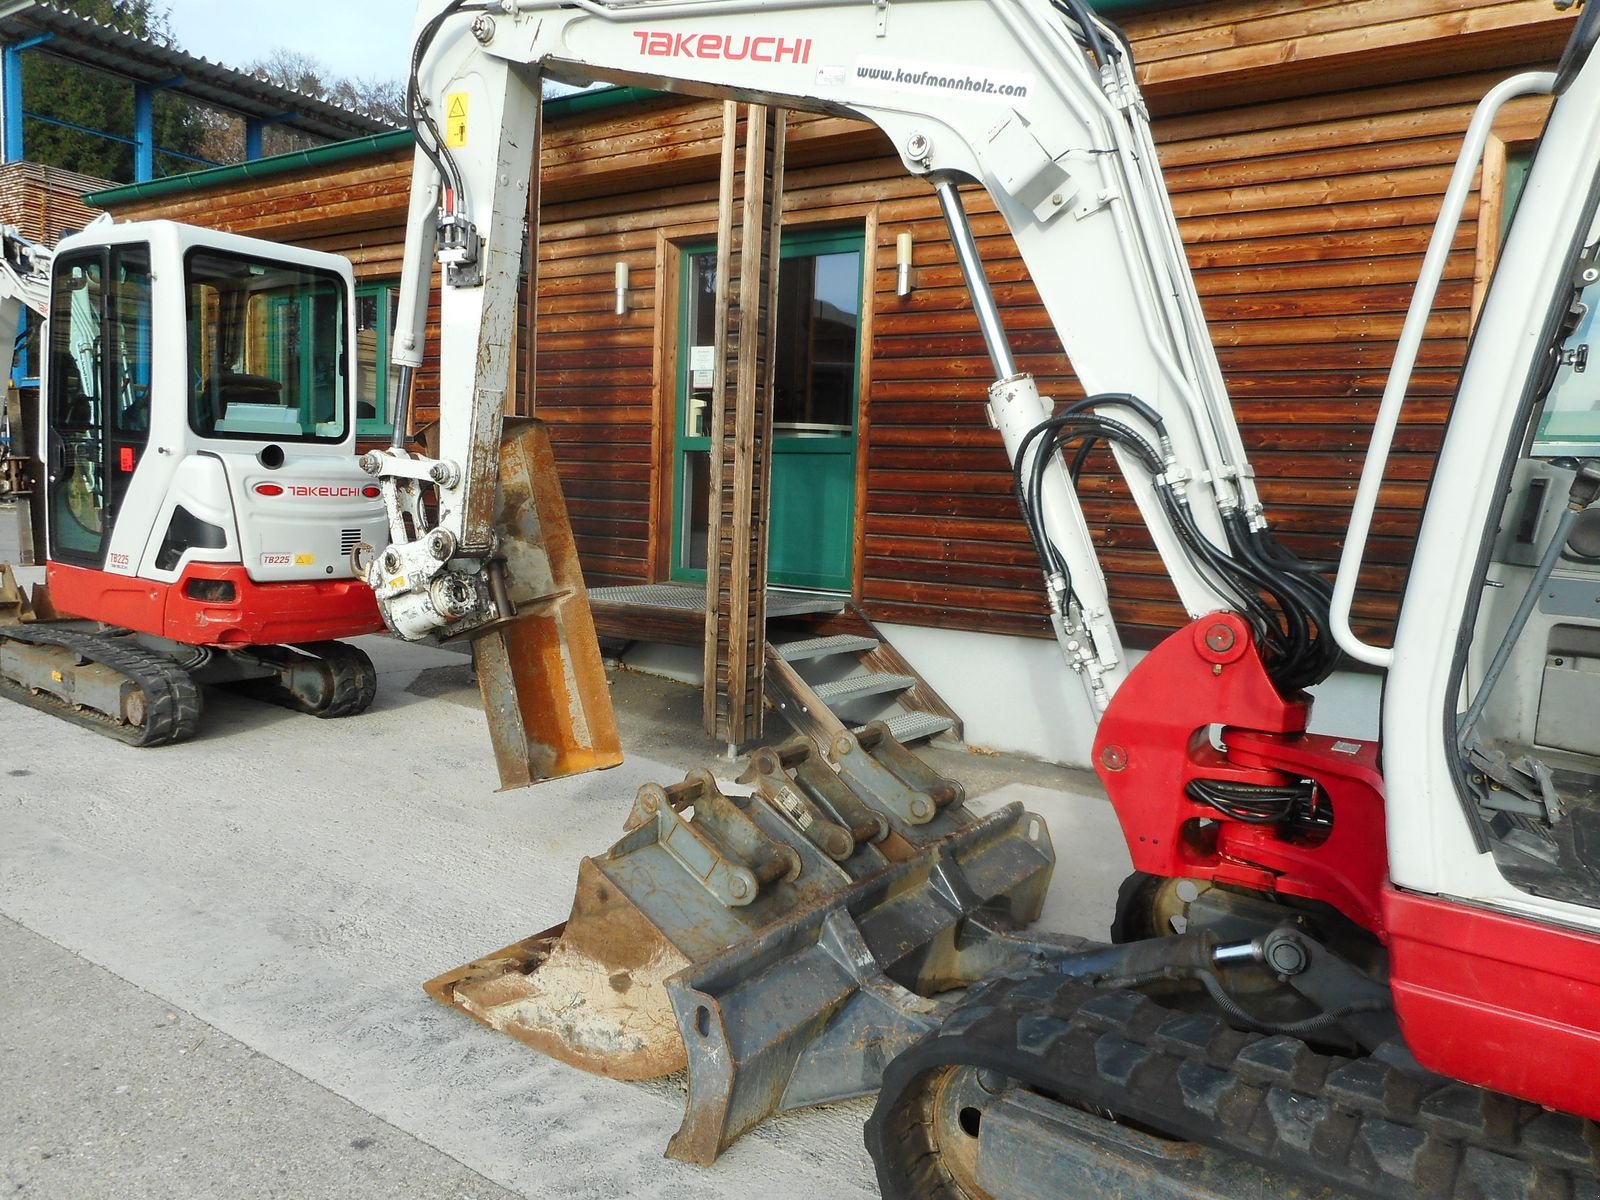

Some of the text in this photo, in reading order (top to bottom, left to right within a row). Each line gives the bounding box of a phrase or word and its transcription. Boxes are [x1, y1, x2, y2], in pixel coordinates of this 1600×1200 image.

[633, 31, 812, 64] TAKEUCHI
[857, 66, 1028, 97] www.kaufmannholz.com
[288, 486, 360, 497] TAKEUCHI
[110, 552, 129, 565] TB225
[263, 554, 290, 564] TB225
